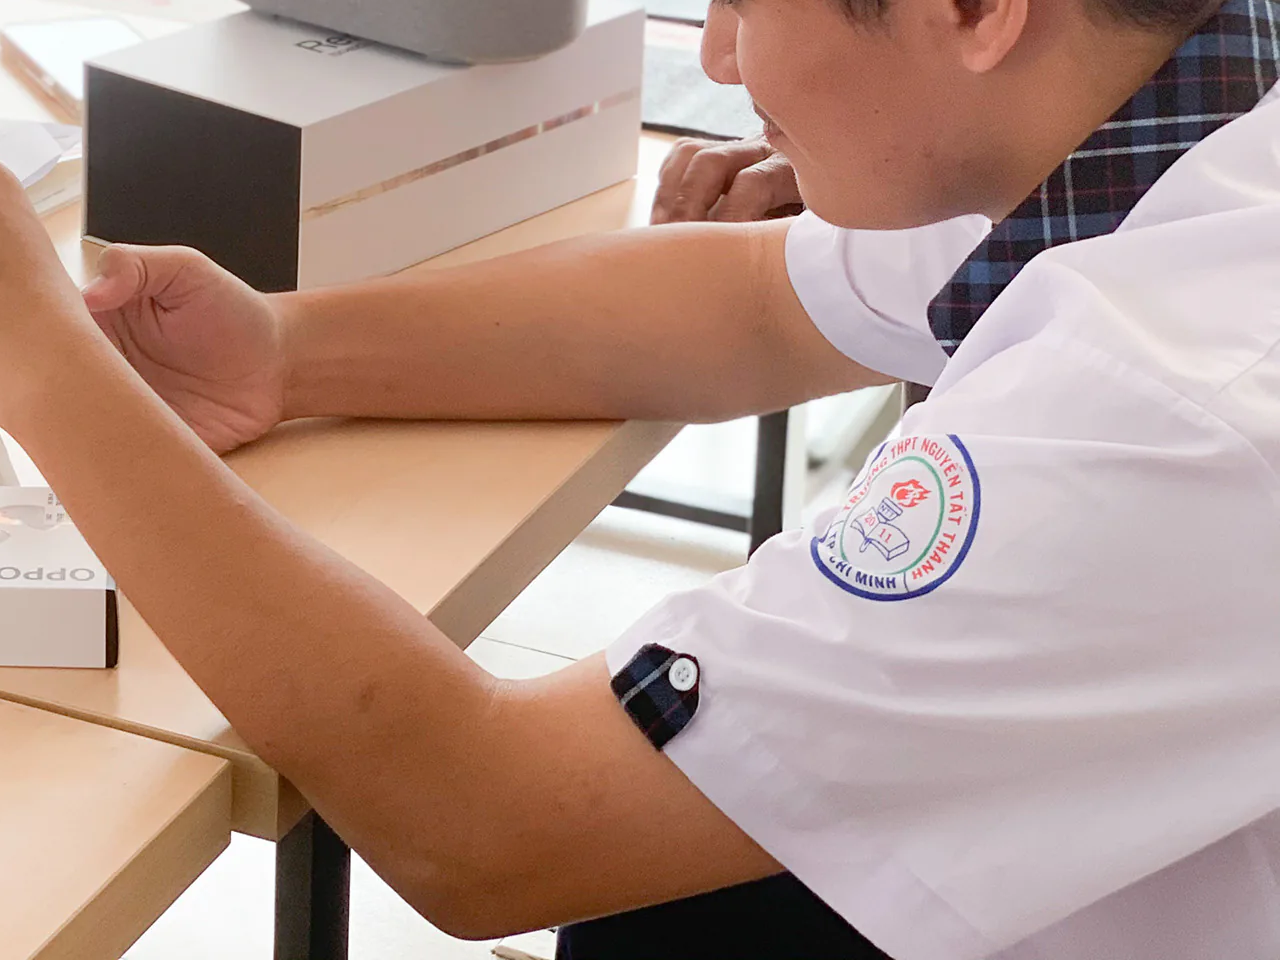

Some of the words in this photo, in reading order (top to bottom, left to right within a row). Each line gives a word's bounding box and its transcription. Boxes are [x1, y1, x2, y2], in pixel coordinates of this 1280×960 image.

[891, 436, 919, 459] THPT
[920, 438, 964, 488] NGUYỄN
[855, 571, 897, 589] MINH
